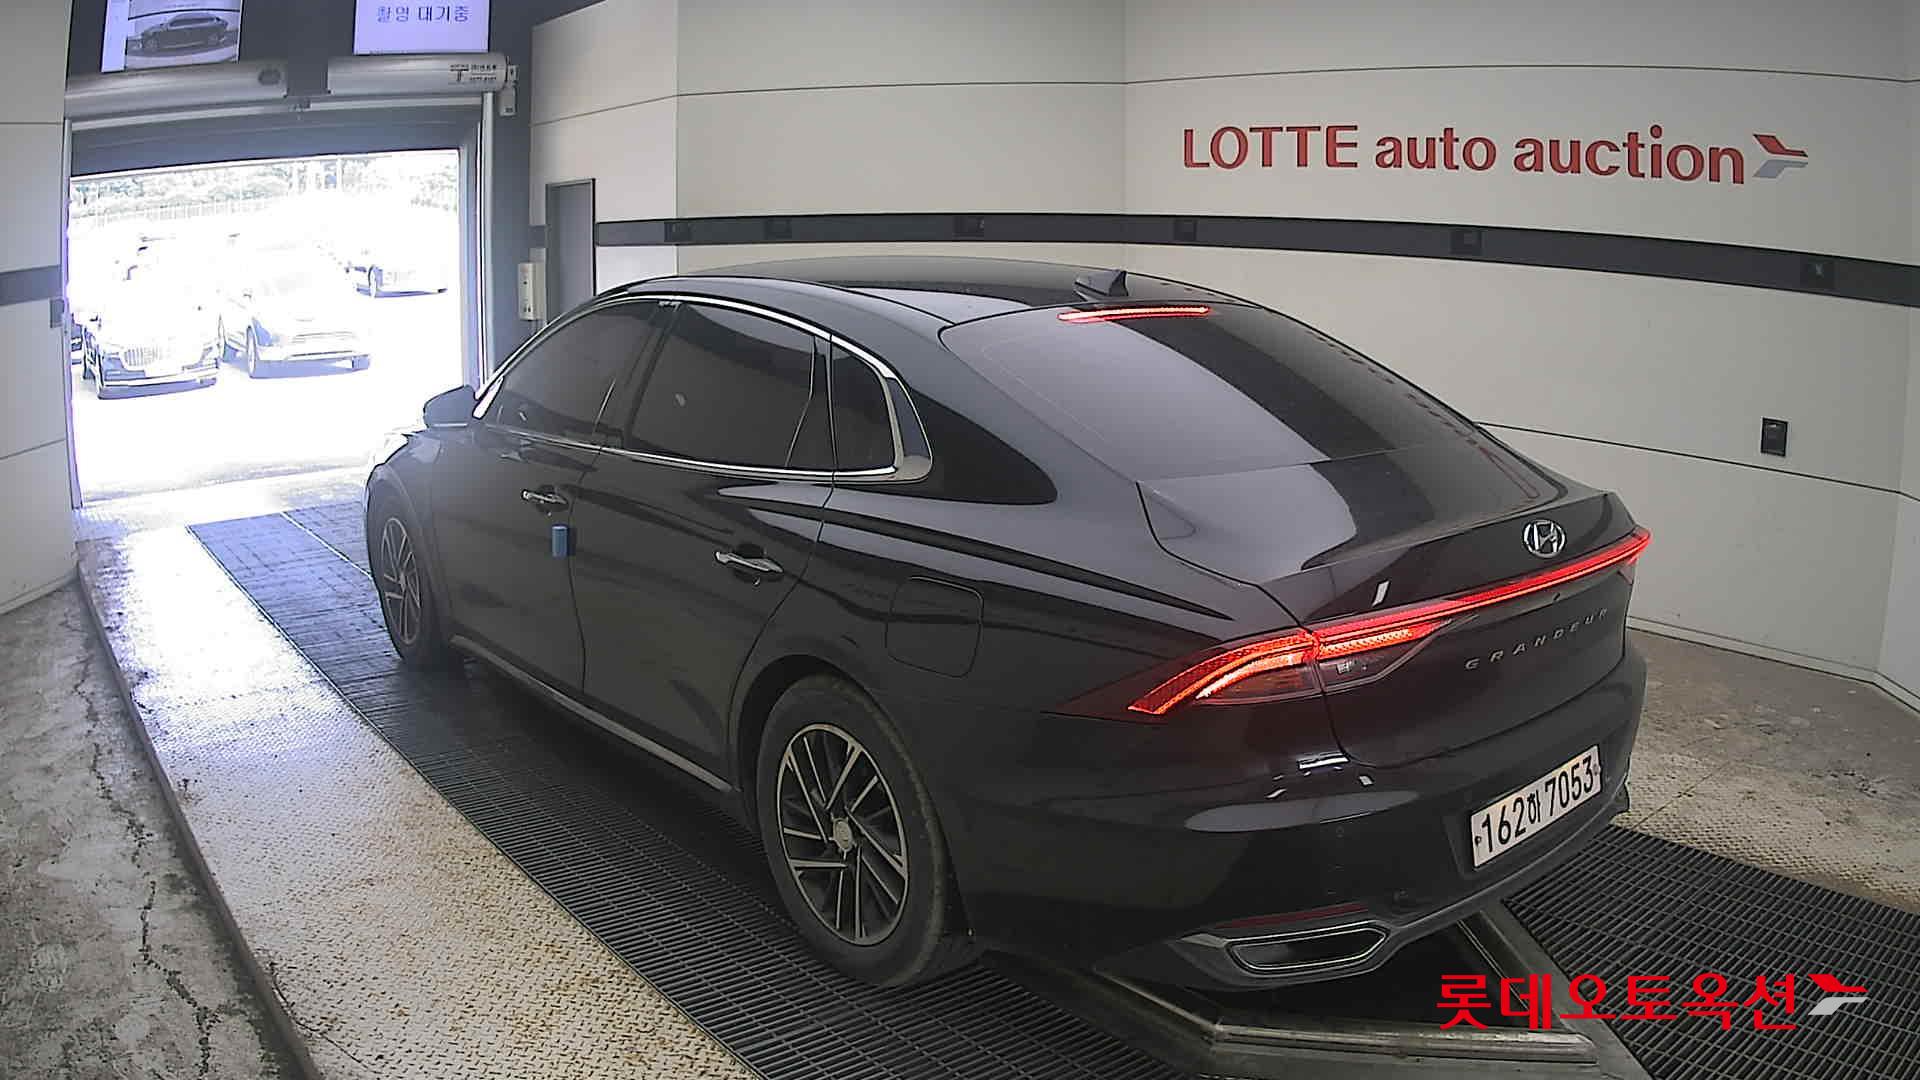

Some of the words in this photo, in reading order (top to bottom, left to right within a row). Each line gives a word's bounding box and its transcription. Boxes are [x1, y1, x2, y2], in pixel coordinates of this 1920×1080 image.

[417, 5, 470, 22] 대기중
[1183, 125, 1359, 169] LOTTE
[1375, 127, 1497, 171] auto
[1513, 124, 1745, 184] auction
[1464, 608, 1609, 671] GRANDEUR
[1481, 789, 1542, 853] 162하
[1545, 754, 1594, 816] 7053
